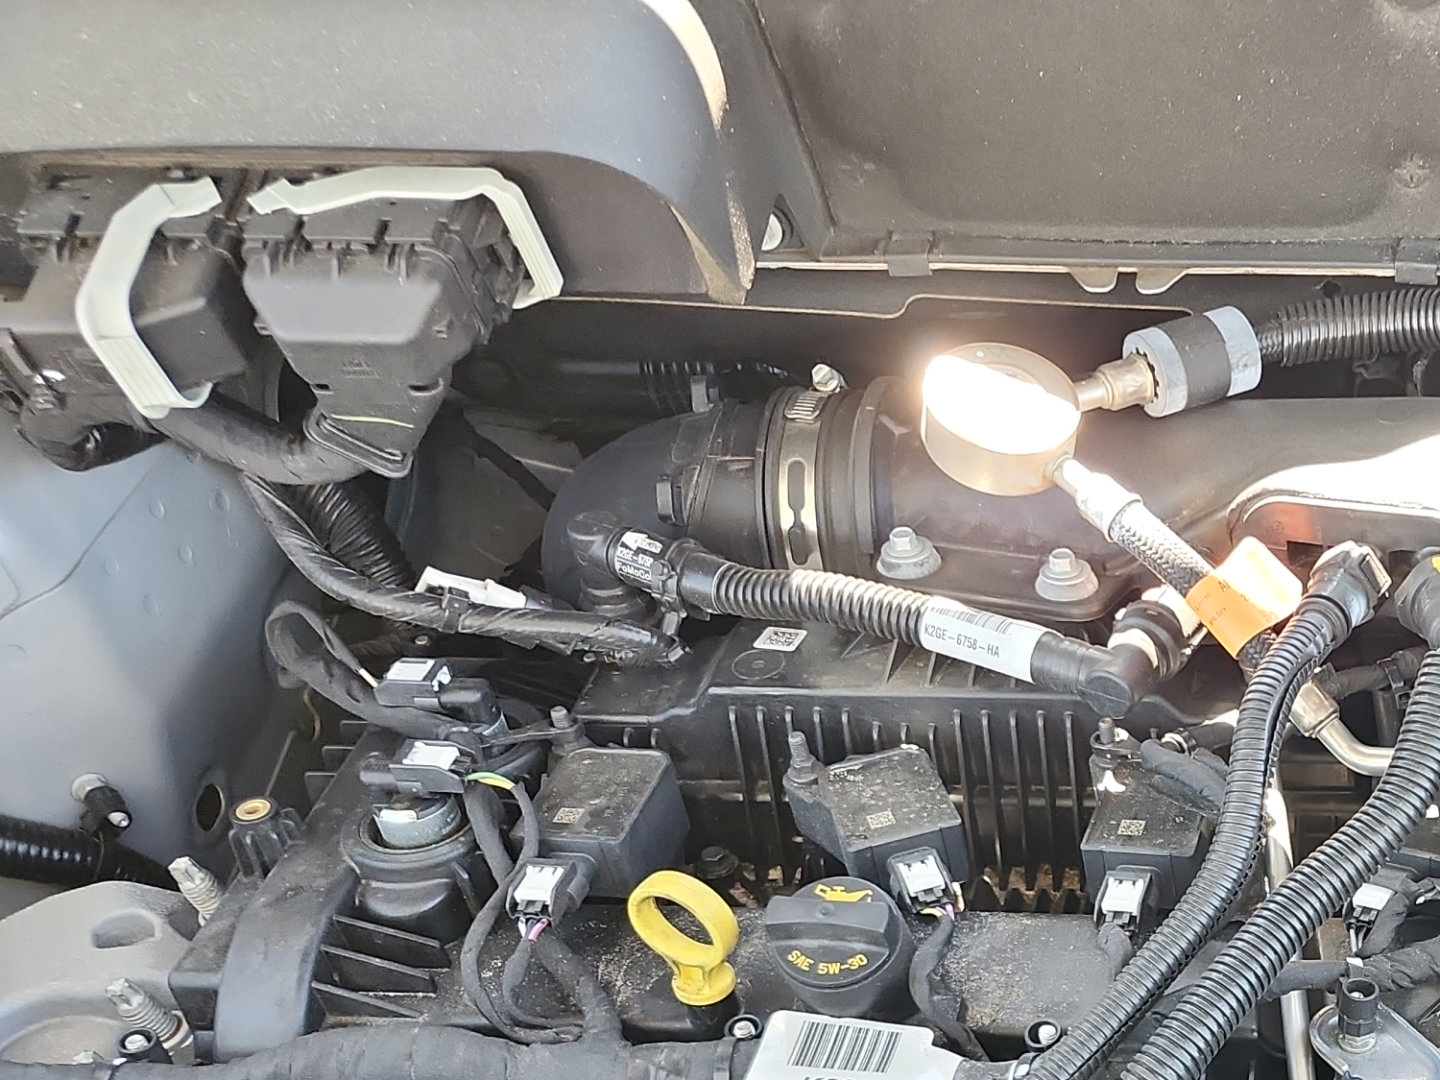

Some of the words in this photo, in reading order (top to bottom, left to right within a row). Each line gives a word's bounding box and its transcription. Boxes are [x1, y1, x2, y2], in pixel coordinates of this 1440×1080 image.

[616, 561, 652, 580] FoMoCo
[924, 623, 1000, 658] K2GE-6758-HA
[787, 949, 815, 971] SAE
[817, 953, 868, 975] 5W-30
